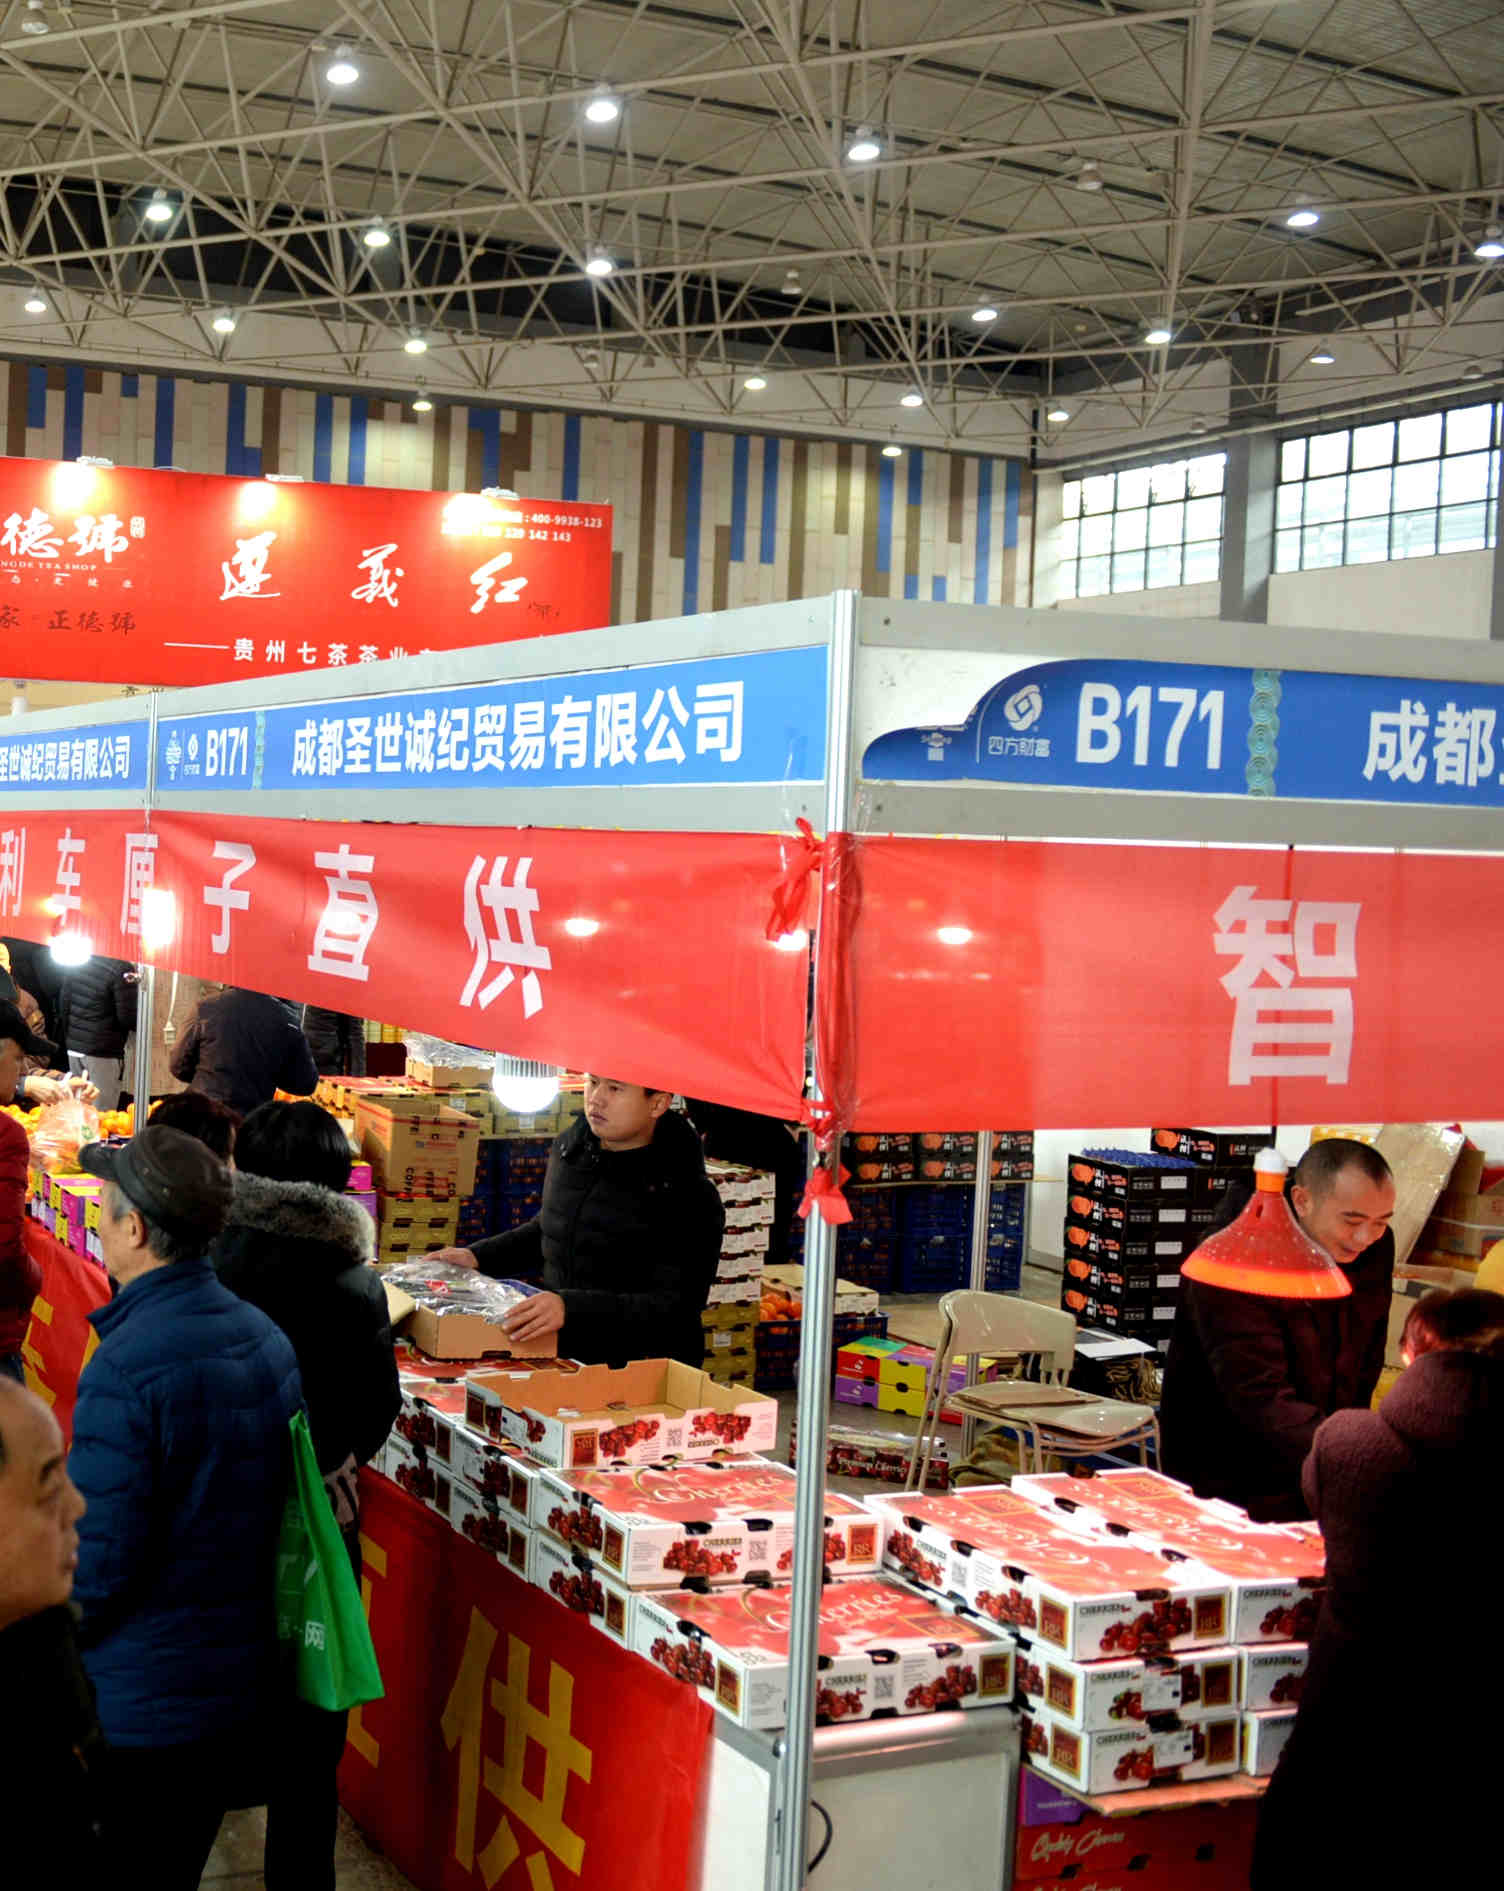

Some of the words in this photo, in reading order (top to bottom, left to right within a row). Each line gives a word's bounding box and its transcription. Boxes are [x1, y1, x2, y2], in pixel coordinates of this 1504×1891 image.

[64, 564, 97, 572] SHOP
[233, 637, 445, 665] 贵州七茶茶业
[205, 726, 249, 777] B171
[292, 680, 743, 776] 成都圣世诚纪贸易有限公司
[1076, 682, 1224, 769] B171
[1363, 699, 1504, 788] 成都
[1212, 885, 1363, 1087] 智
